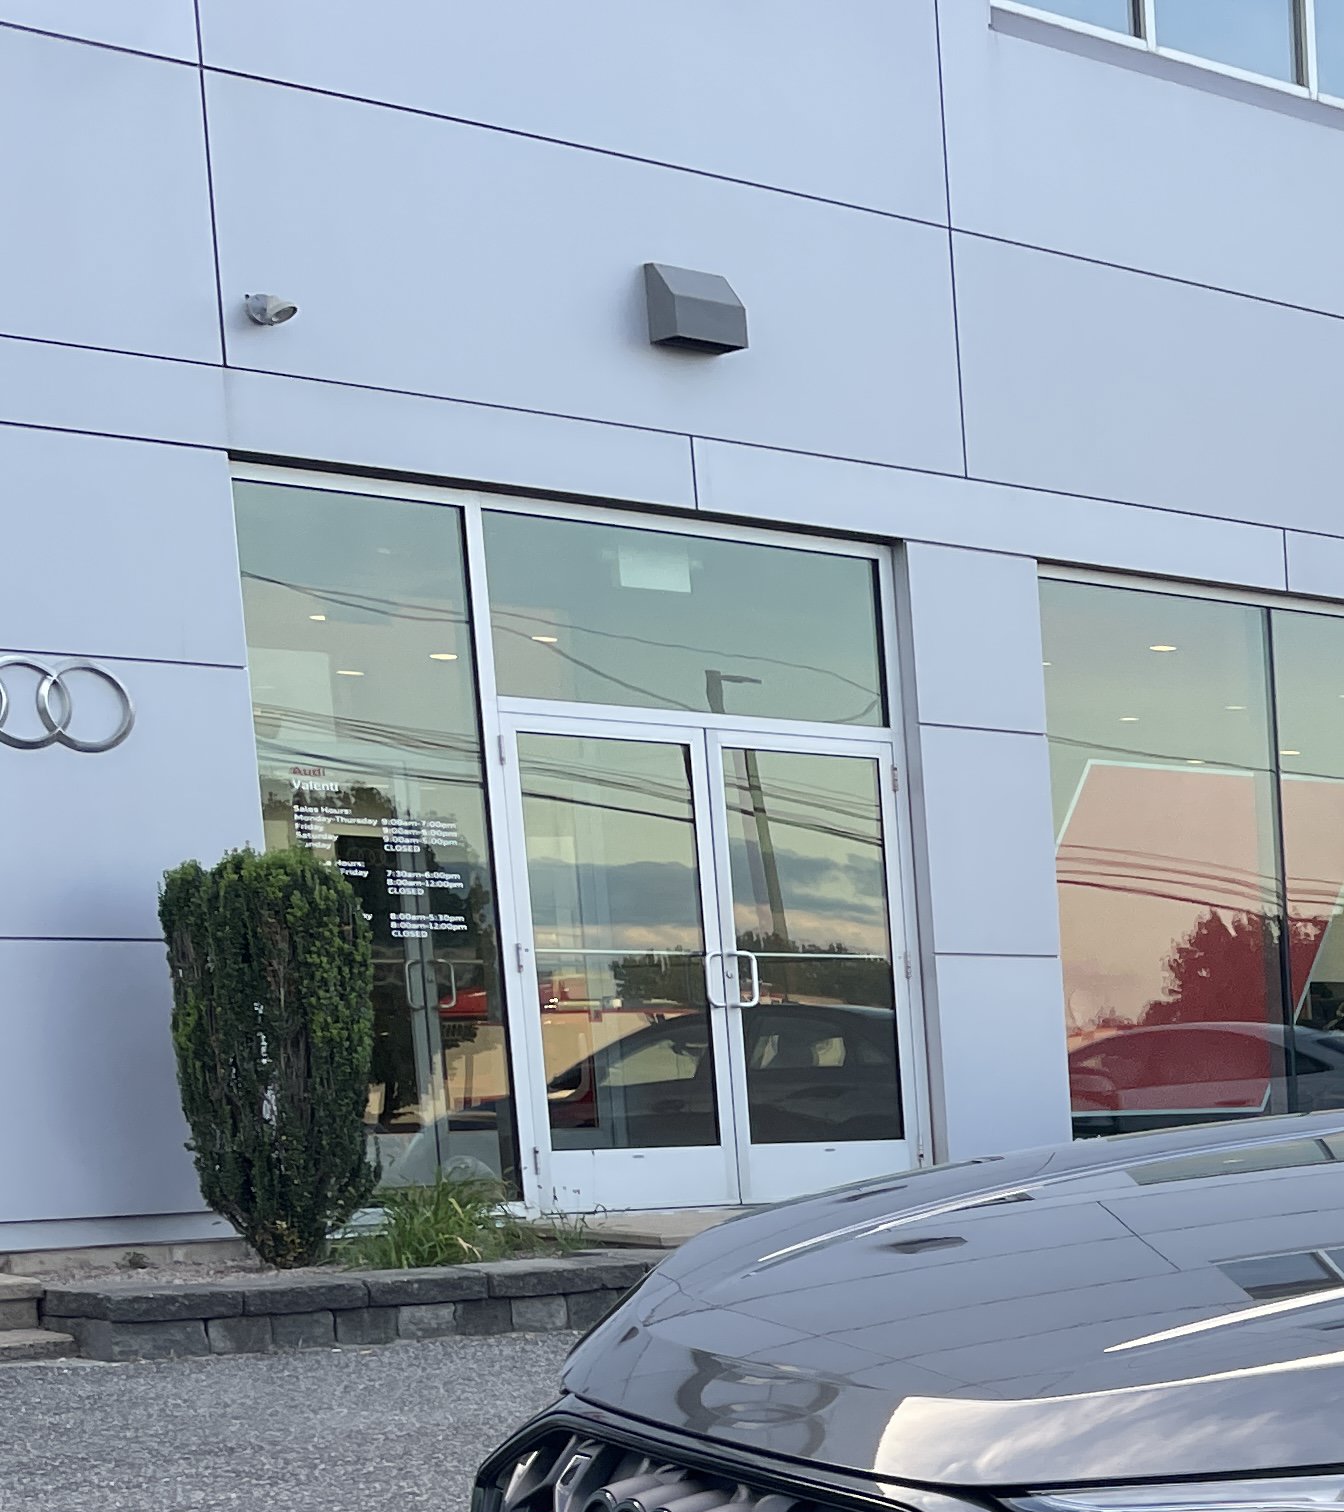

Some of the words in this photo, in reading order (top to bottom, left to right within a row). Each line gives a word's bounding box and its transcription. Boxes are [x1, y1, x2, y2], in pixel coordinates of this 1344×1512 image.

[292, 767, 326, 777] Audi
[292, 779, 339, 792] Valenti
[293, 804, 319, 813] Sales
[321, 806, 352, 815] Hours:
[294, 813, 378, 827] Monday-Thursday
[294, 822, 325, 832] Friday
[295, 831, 339, 841] Saturday
[384, 844, 421, 853] CLOSED
[387, 886, 425, 895] CLOSED
[391, 929, 428, 938] CLOSED
